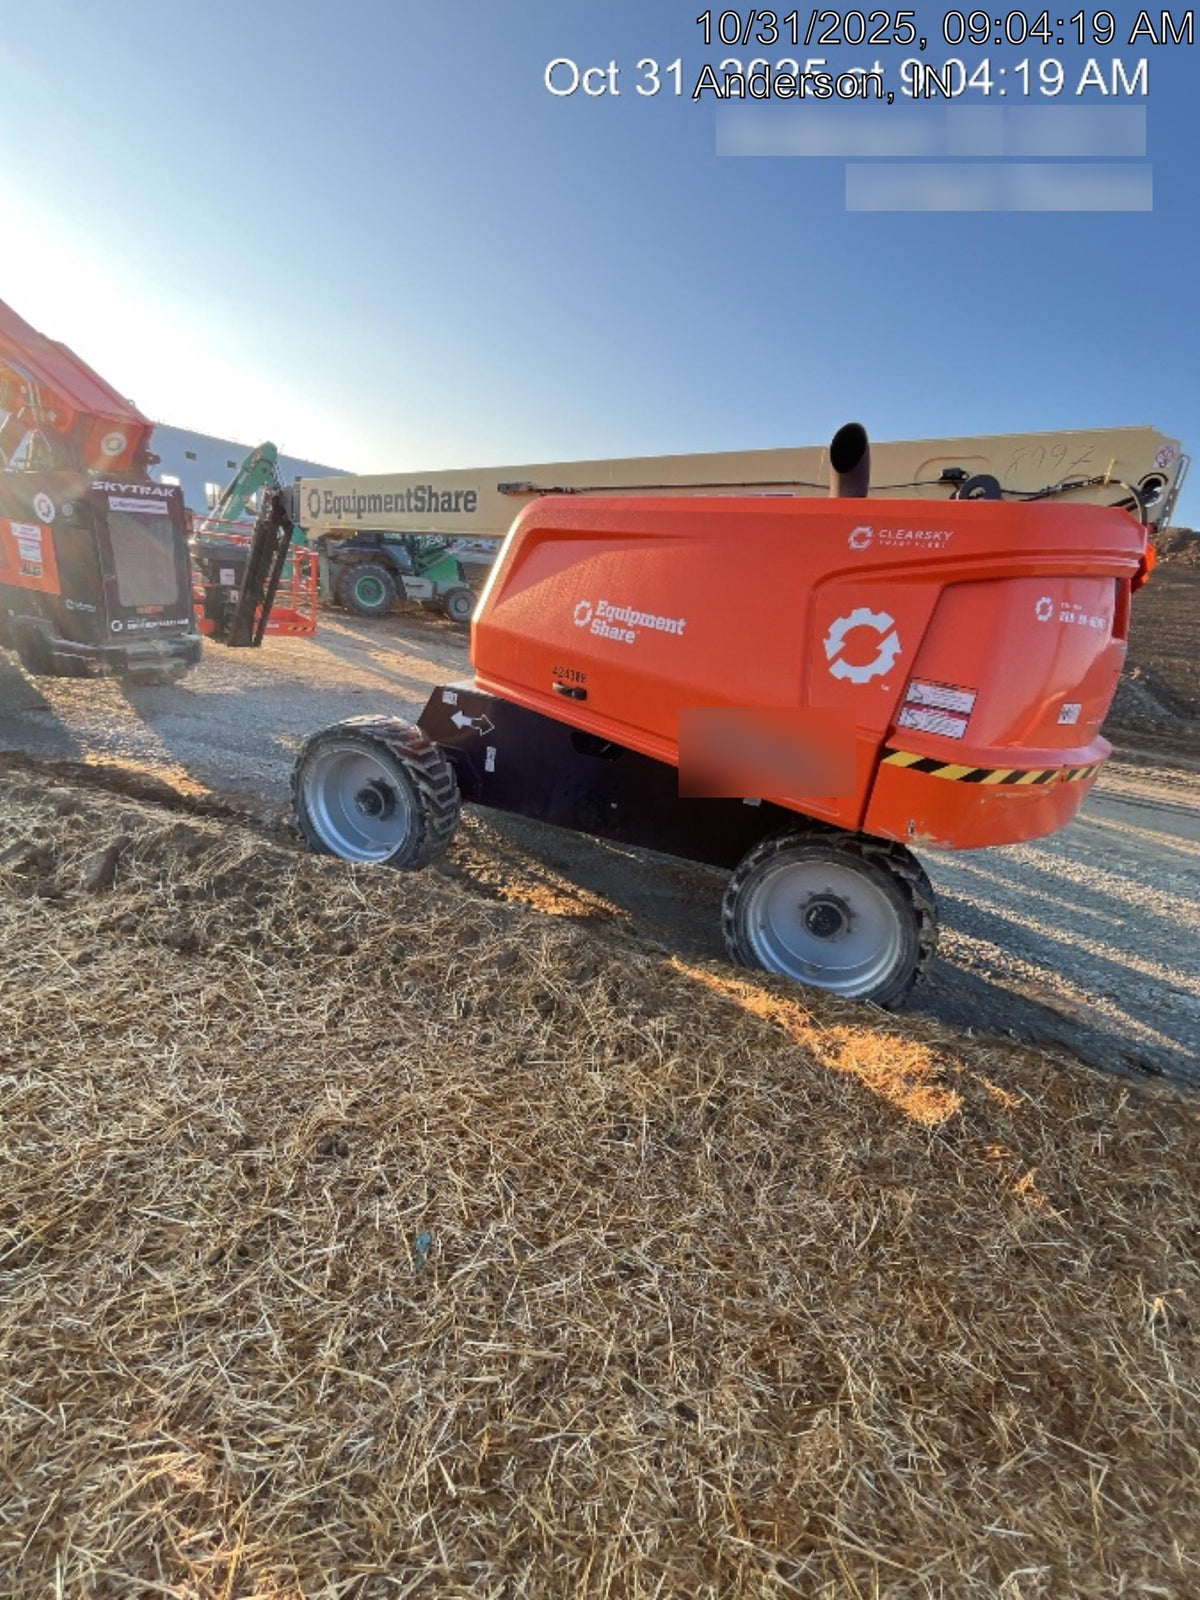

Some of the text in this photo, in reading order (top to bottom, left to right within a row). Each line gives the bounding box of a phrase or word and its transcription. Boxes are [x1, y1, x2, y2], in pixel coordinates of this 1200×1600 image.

[92, 481, 175, 497] SKYTRAK
[323, 485, 478, 519] EquipmentShare
[879, 529, 954, 541] CLEARSKY
[596, 600, 687, 635] Equipment
[590, 619, 635, 644] Share
